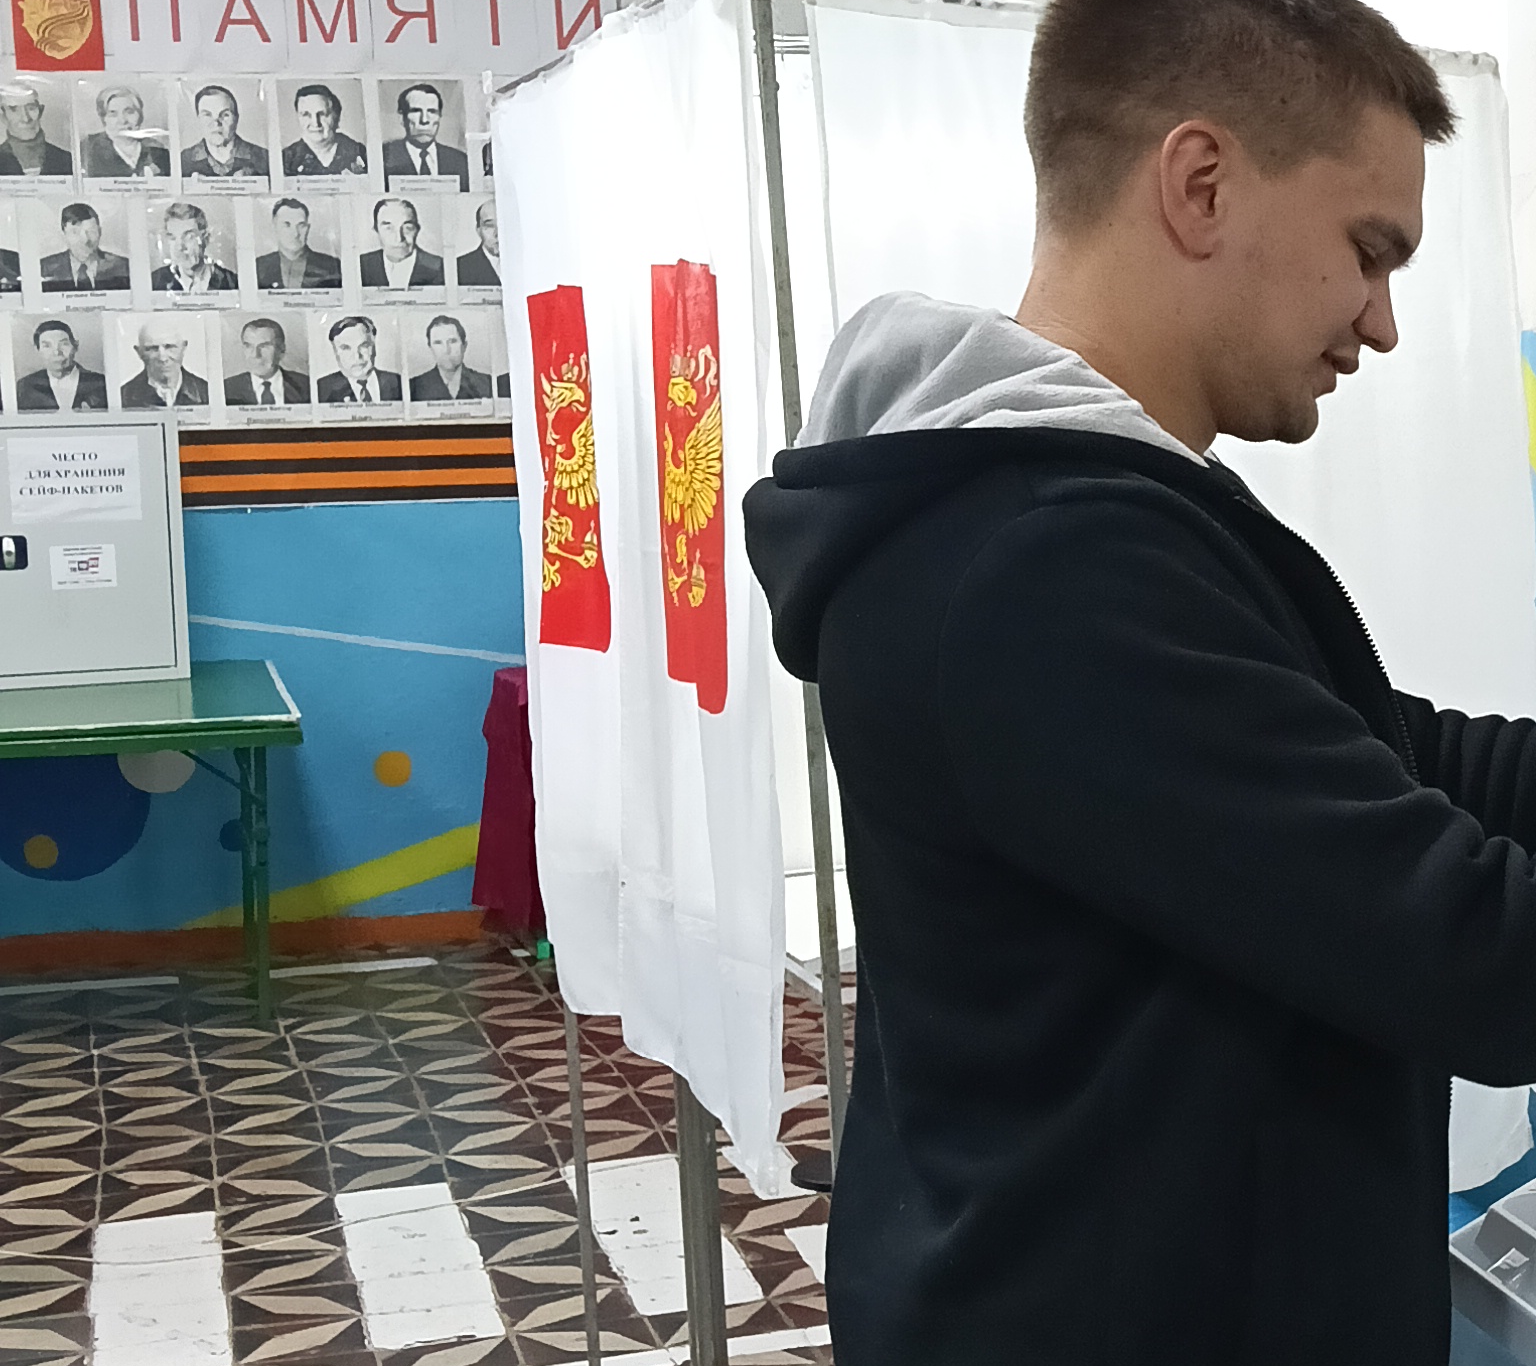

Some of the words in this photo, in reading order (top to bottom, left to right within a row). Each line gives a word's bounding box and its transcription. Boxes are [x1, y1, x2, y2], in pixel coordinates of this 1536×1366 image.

[51, 452, 98, 463] МЕСТО
[25, 469, 51, 480] ДЛЯ
[55, 468, 125, 479] ХРАНЕНИЯ
[19, 485, 123, 496] СЕЙФ-ПАКЕТОВ
